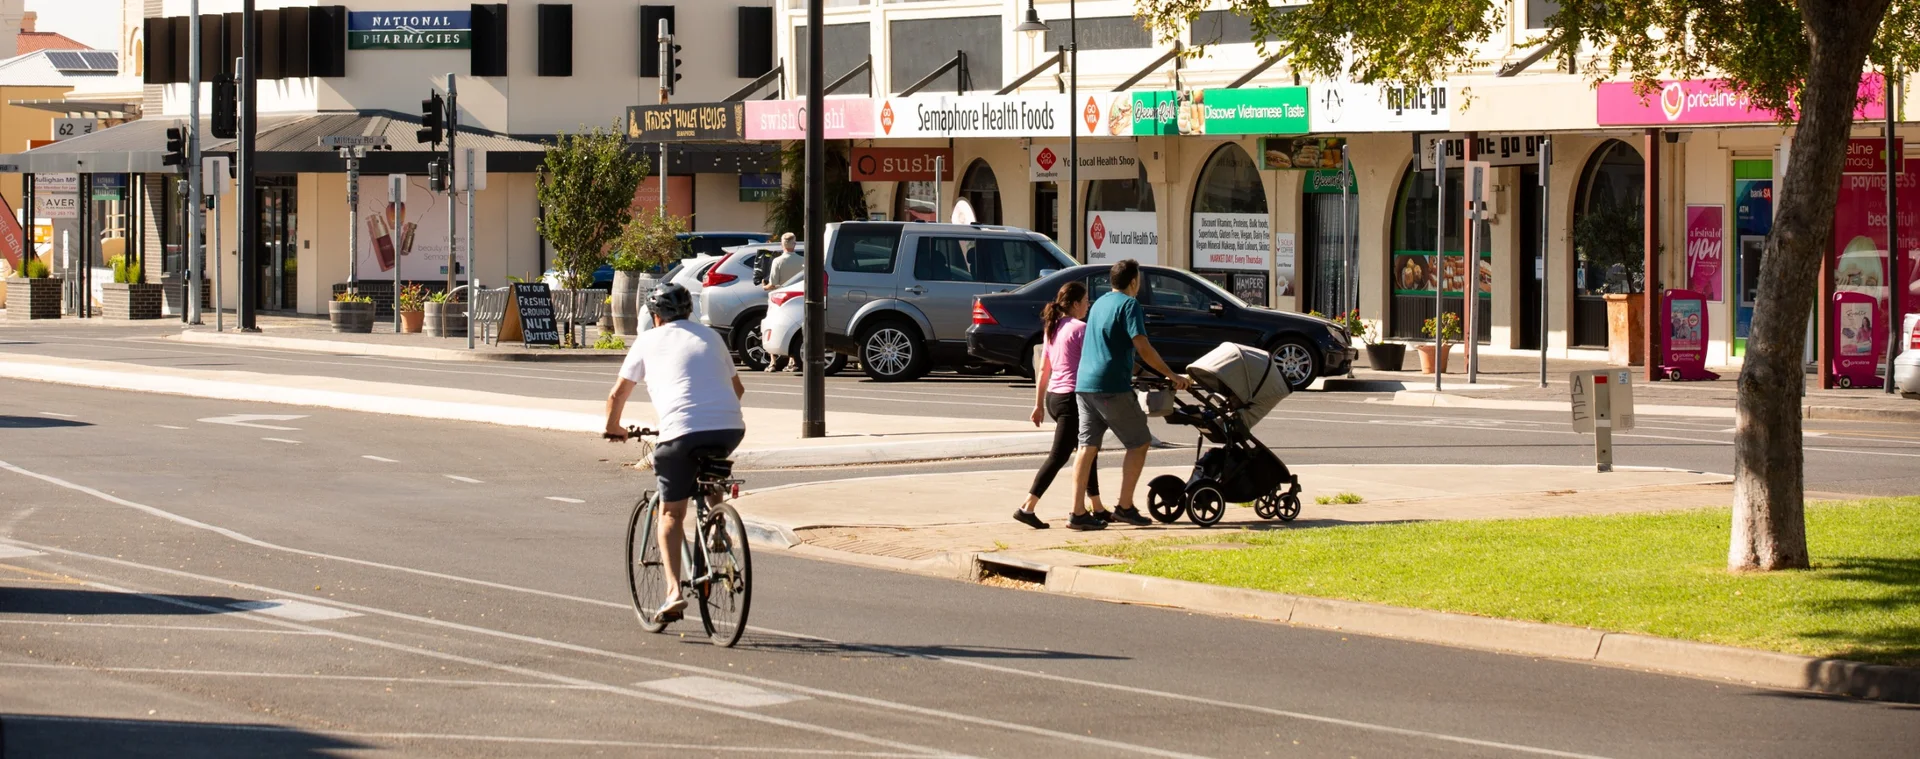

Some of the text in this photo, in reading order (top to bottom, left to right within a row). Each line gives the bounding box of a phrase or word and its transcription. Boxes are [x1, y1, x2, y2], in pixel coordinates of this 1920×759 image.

[373, 16, 451, 26] NATIONAL
[363, 34, 460, 44] PHARMACIES
[1431, 87, 1446, 115] go
[1688, 89, 1736, 111] priceline
[883, 108, 891, 117] GO
[1087, 104, 1096, 113] GO
[1205, 103, 1305, 119] Discover Vietnamese Taste
[760, 104, 845, 130] swish shi
[882, 117, 892, 126] VITA
[917, 101, 1055, 135] Semaphore Health Foods
[1086, 114, 1096, 124] VITA
[59, 123, 74, 136] 62
[1445, 138, 1495, 160] Agnt
[1501, 136, 1520, 158] go
[883, 153, 947, 173] sushi
[1079, 157, 1095, 167] Local
[1096, 156, 1118, 166] Health
[1119, 155, 1135, 166] Shop
[1895, 173, 1916, 187] ess
[1109, 231, 1120, 244] Your
[1121, 231, 1132, 245] Local
[1133, 231, 1148, 245] Health
[1695, 227, 1714, 237] festival
[1689, 238, 1721, 278] you
[1236, 278, 1264, 290] HAMPERS
[518, 296, 551, 306] FRESHLY
[521, 307, 551, 316] GROUND
[526, 317, 550, 329] NUT
